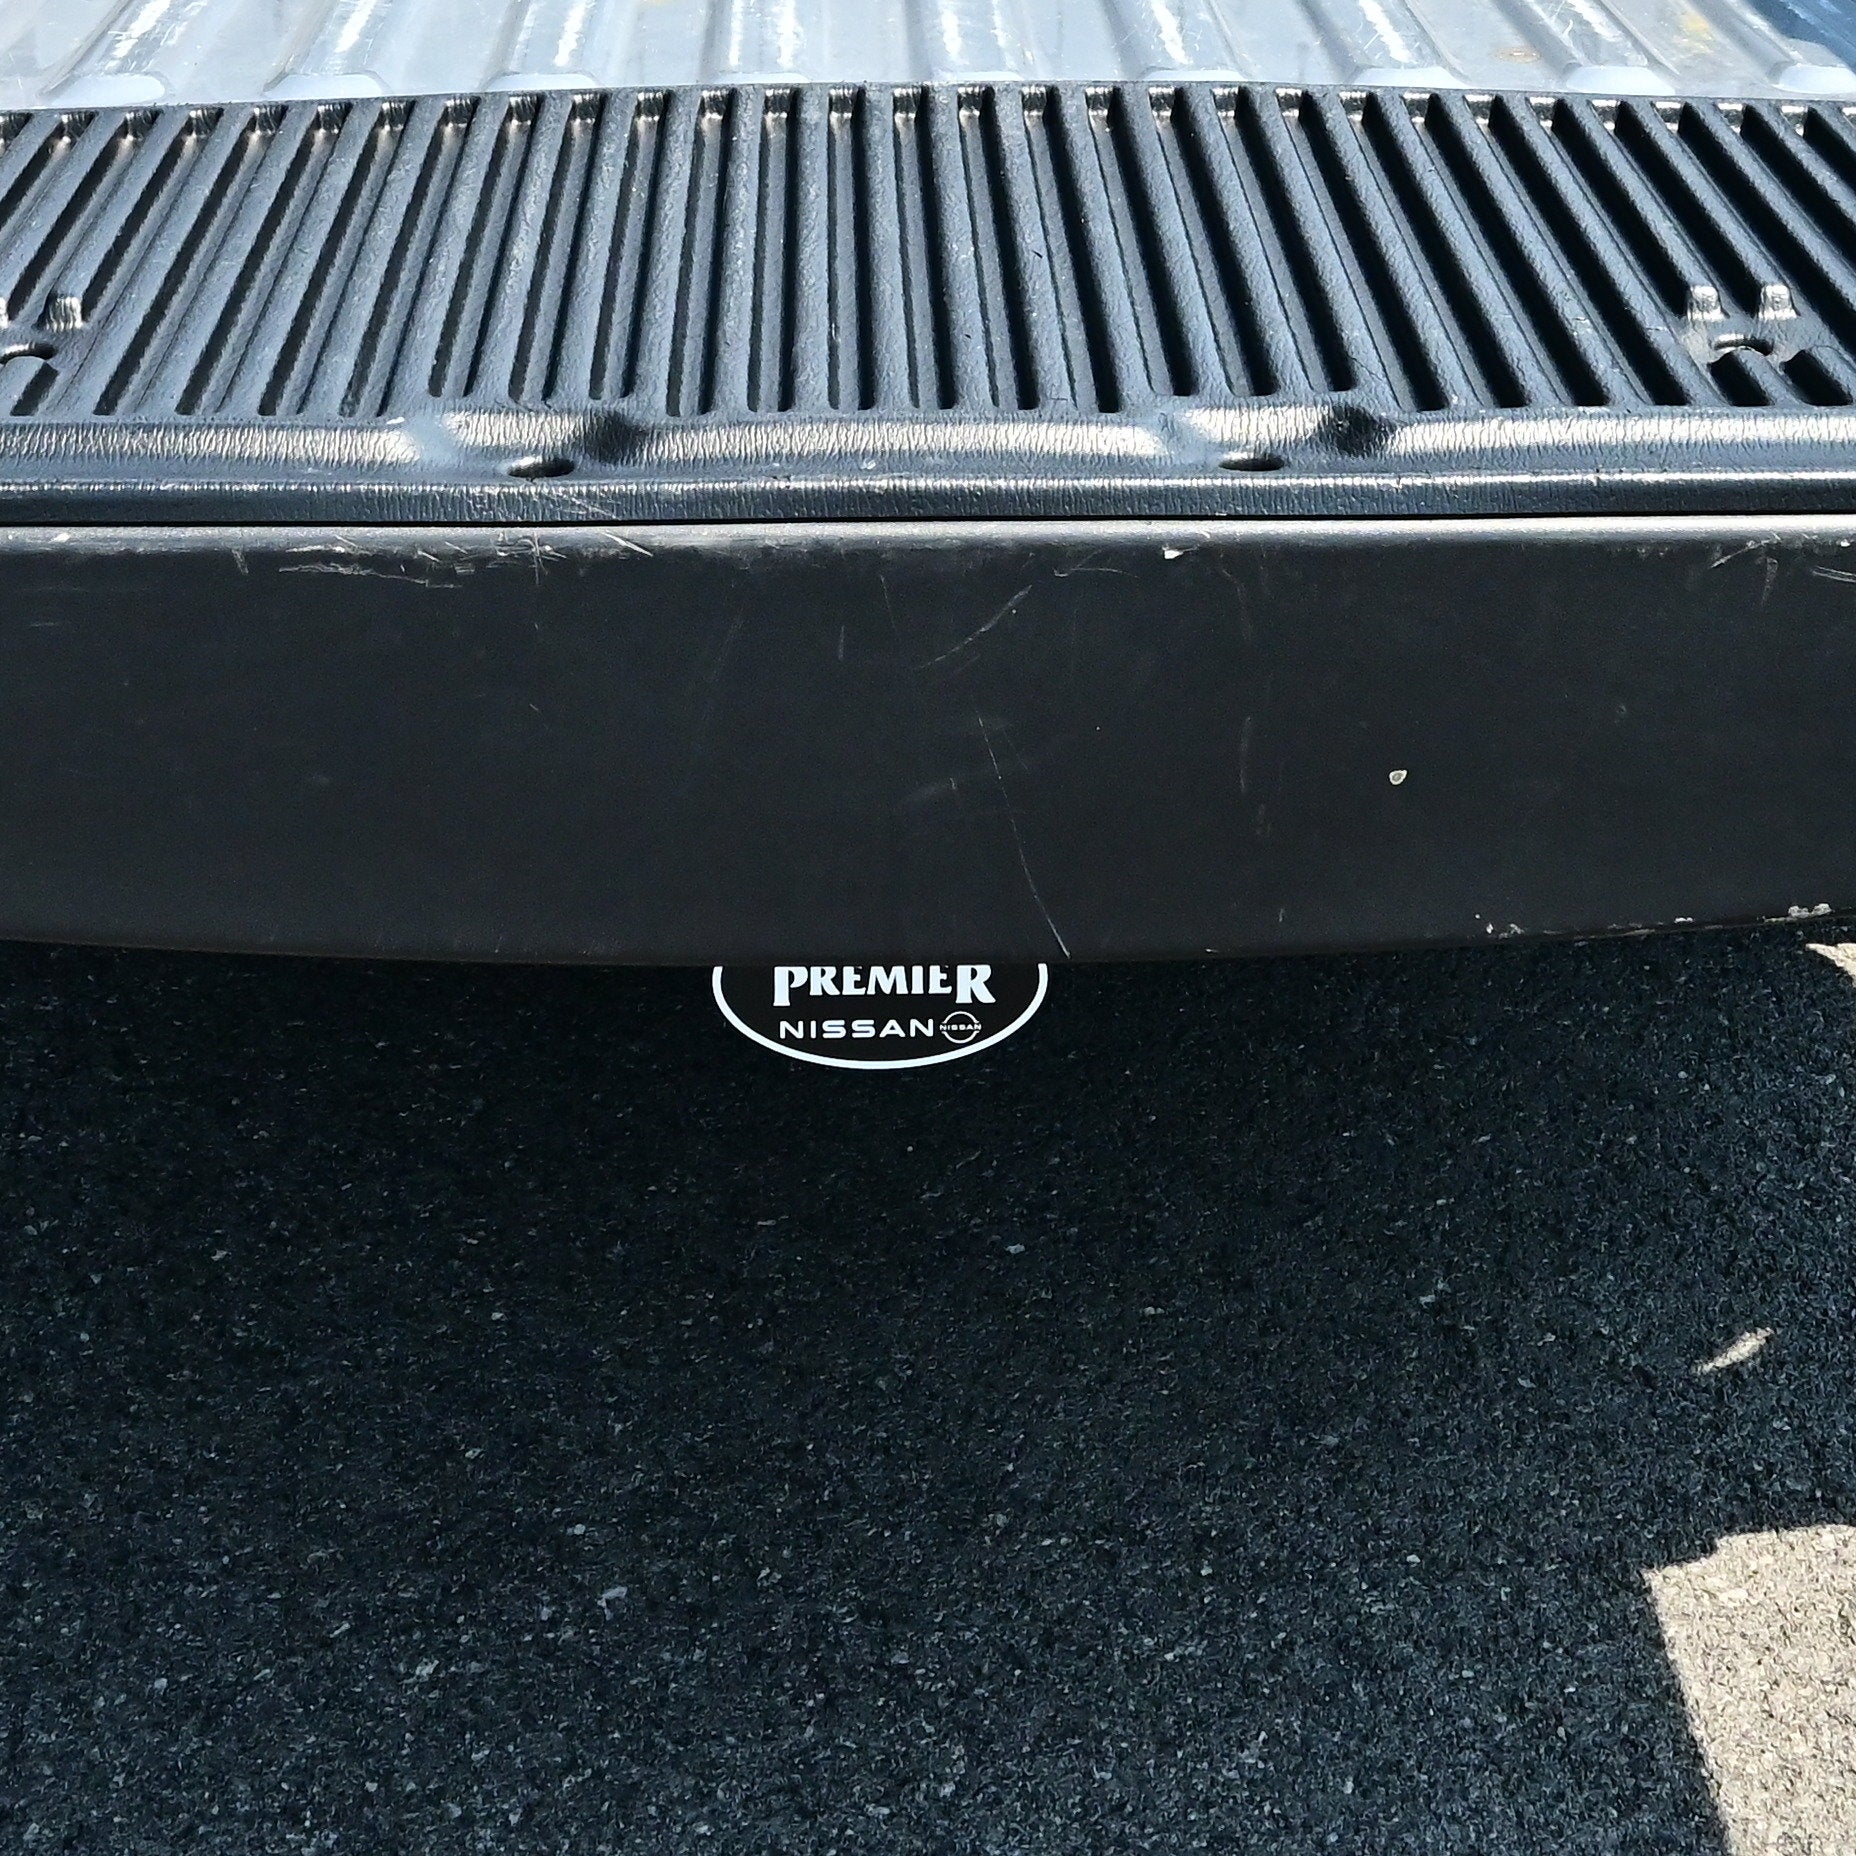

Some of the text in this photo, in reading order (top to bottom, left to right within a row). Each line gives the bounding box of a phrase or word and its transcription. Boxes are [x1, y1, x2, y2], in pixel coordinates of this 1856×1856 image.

[773, 964, 996, 1007] PREMIER
[779, 1018, 982, 1038] NISSAN NISSAN
